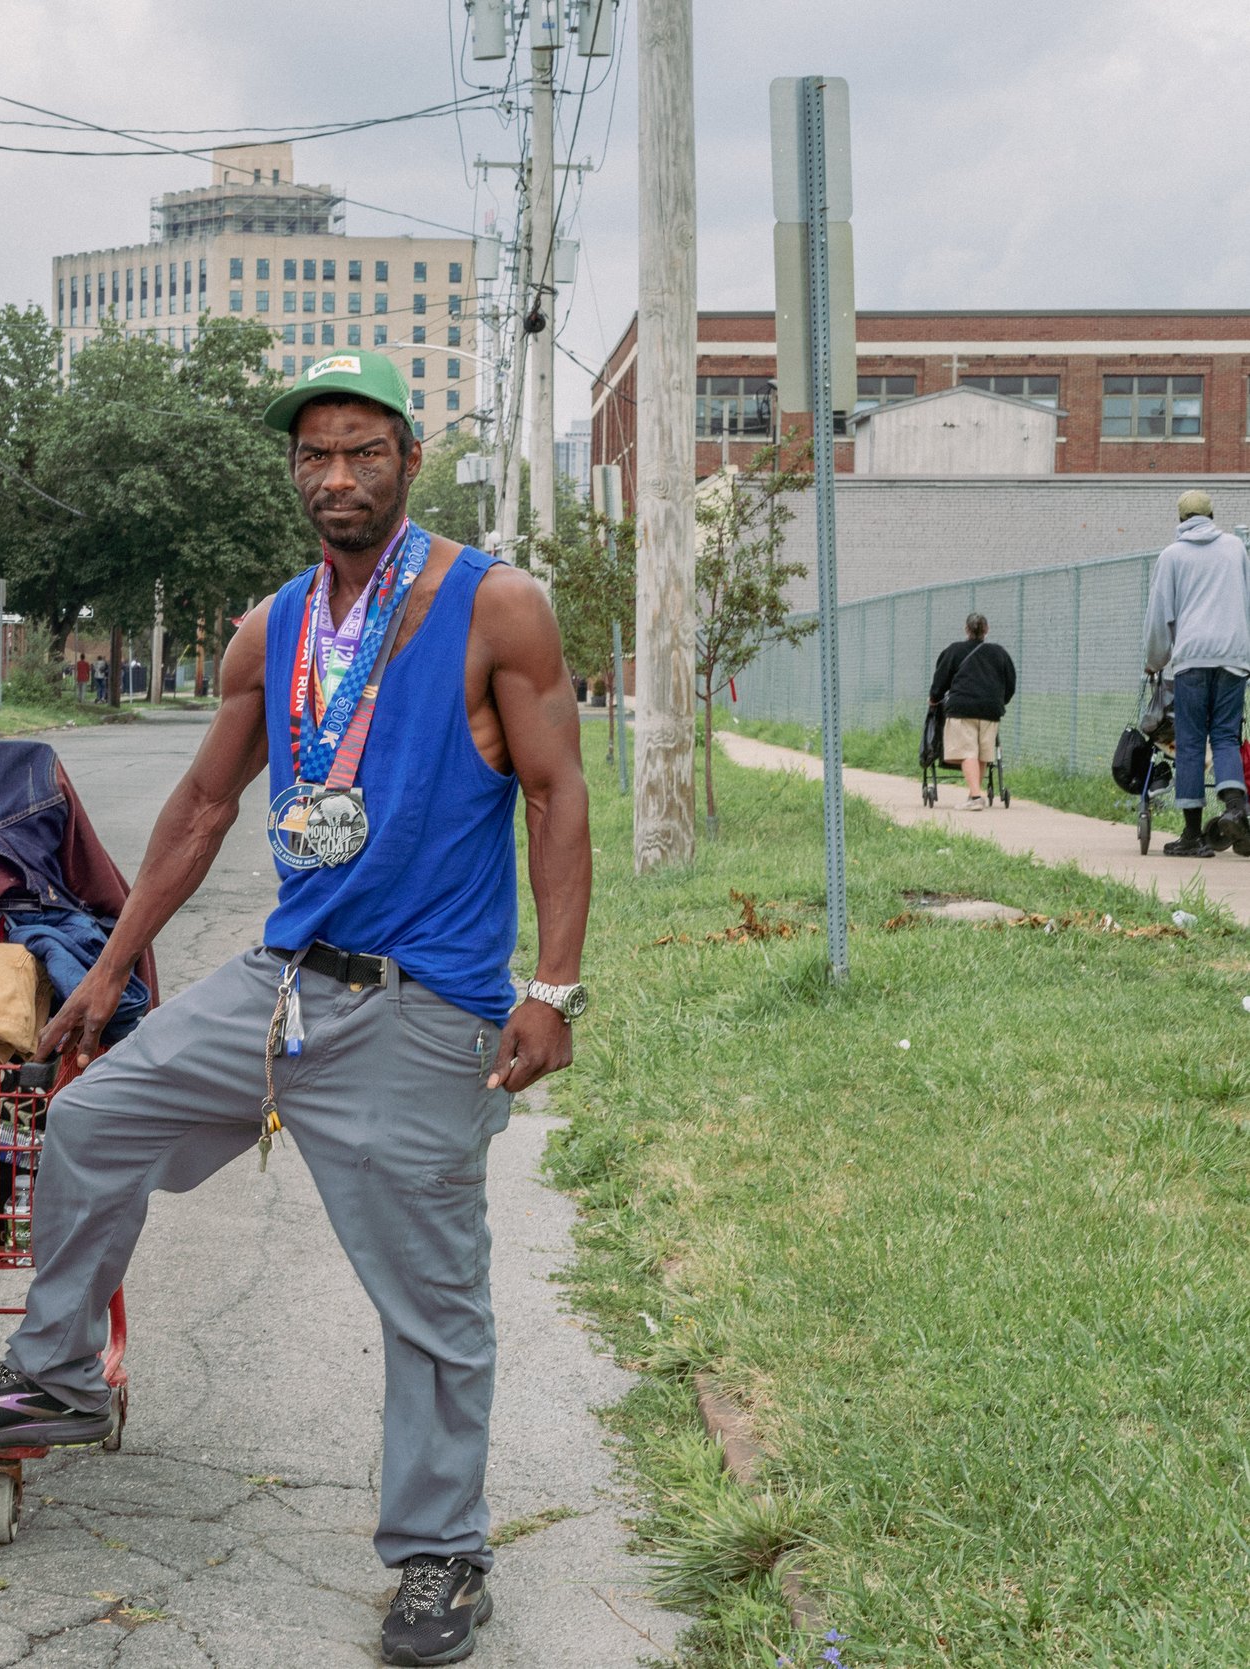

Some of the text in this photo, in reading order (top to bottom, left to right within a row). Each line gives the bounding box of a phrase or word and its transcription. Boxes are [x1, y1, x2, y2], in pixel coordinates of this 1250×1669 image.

[346, 607, 361, 635] RACE
[295, 676, 307, 712] RUN
[319, 697, 354, 750] 500K
[307, 825, 351, 840] MOUNTAIN
[317, 838, 351, 855] GOAT
